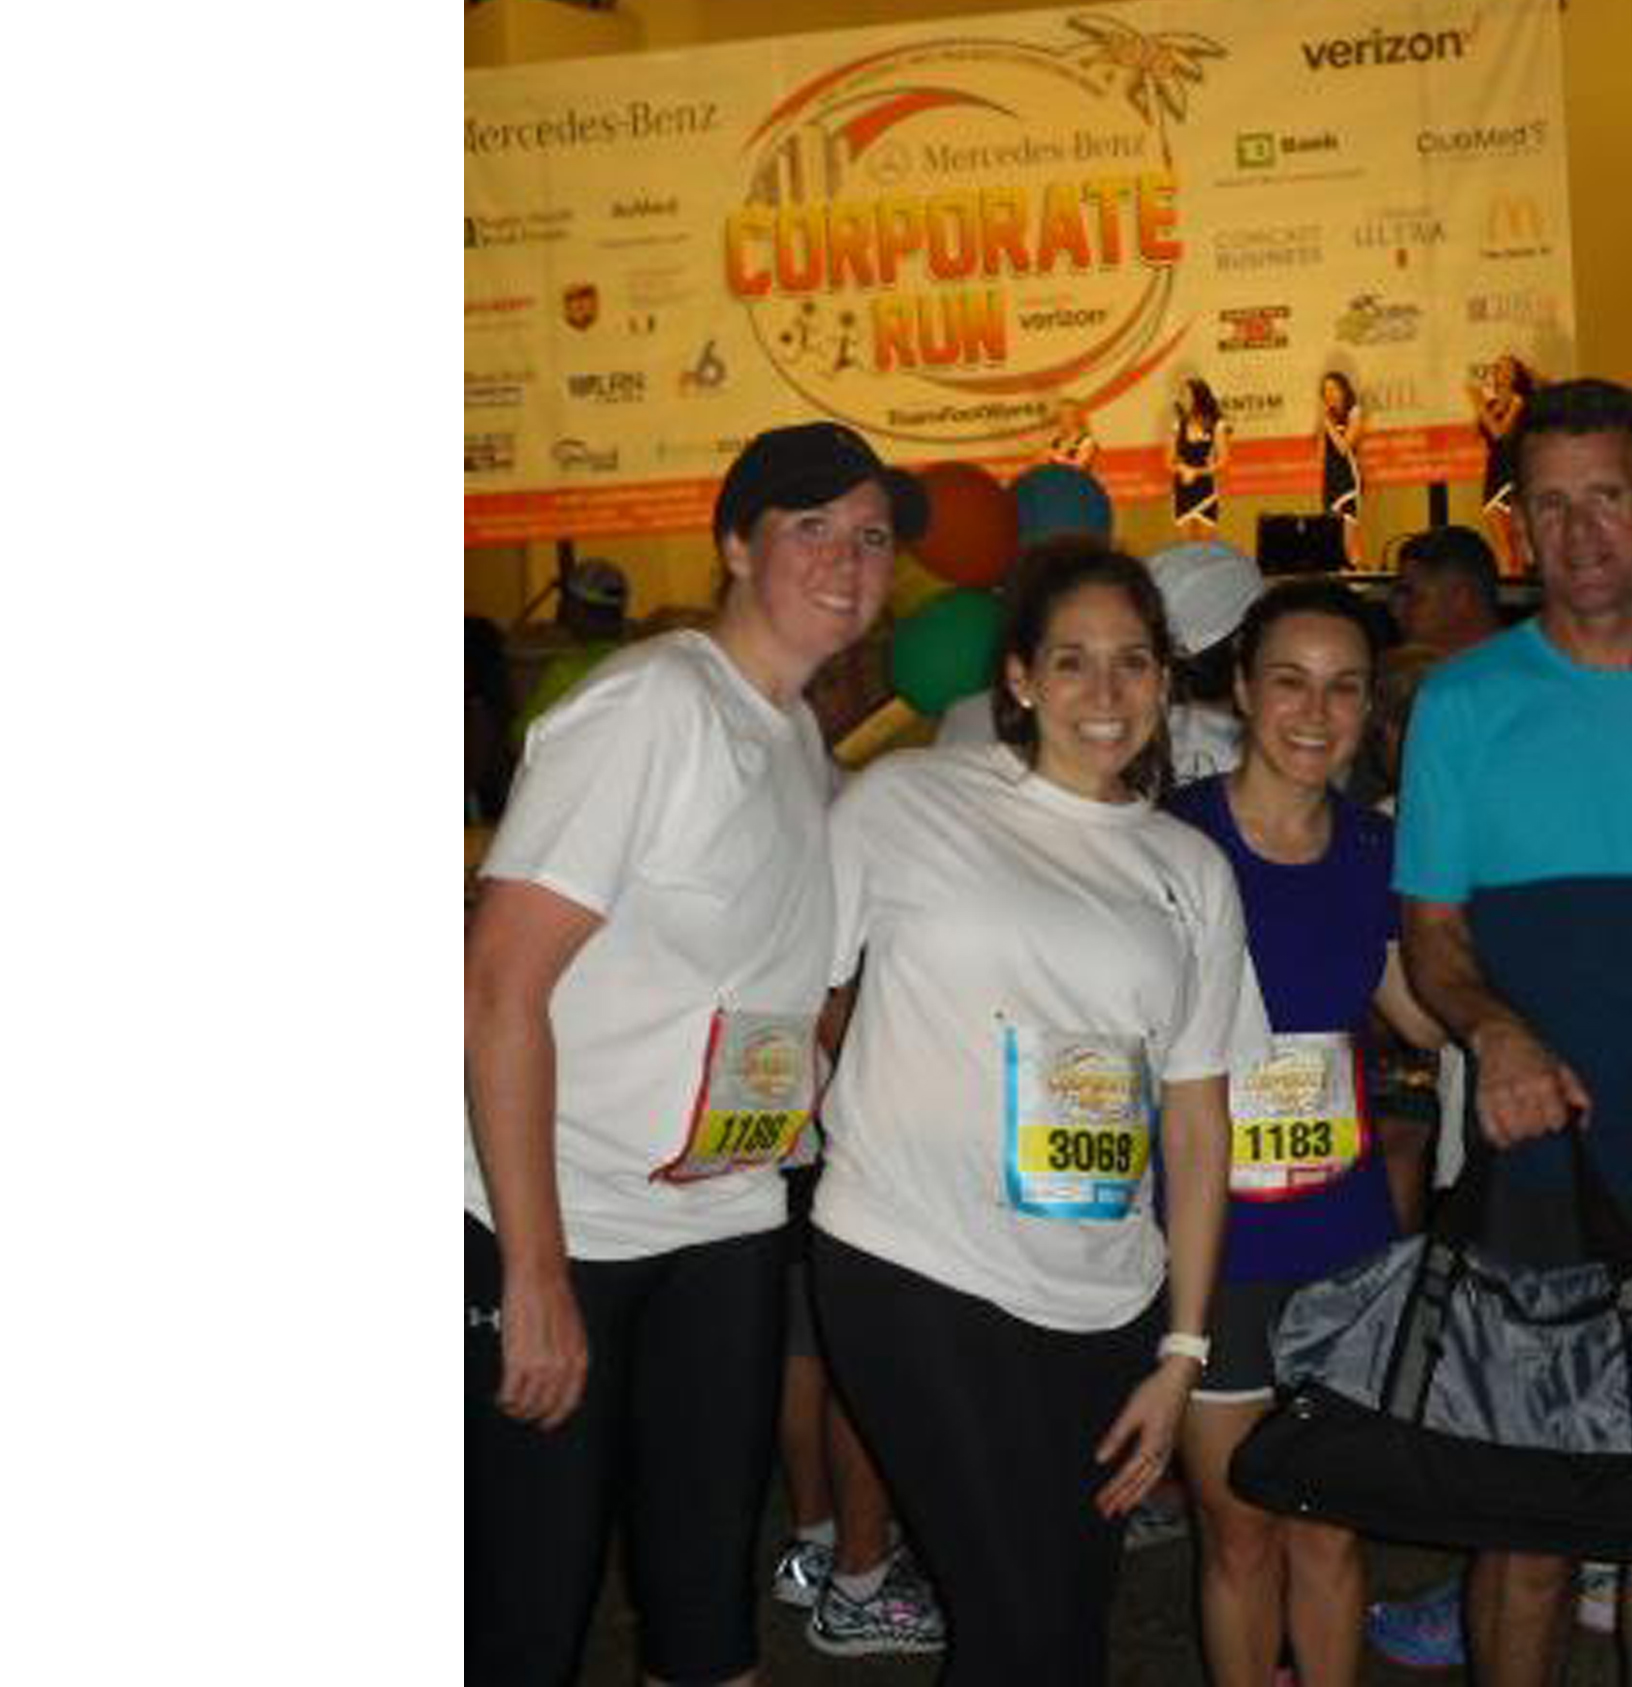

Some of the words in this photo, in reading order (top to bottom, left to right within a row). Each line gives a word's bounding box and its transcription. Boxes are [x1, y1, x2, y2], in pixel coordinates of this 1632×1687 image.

[1302, 26, 1464, 71] verizon
[1280, 133, 1339, 154] Bank
[723, 172, 1185, 299] CORPORATE
[872, 288, 1009, 372] RUN
[1018, 308, 1106, 332] verizon
[1047, 1127, 1134, 1174] 3069
[1244, 1121, 1333, 1161] 1183
